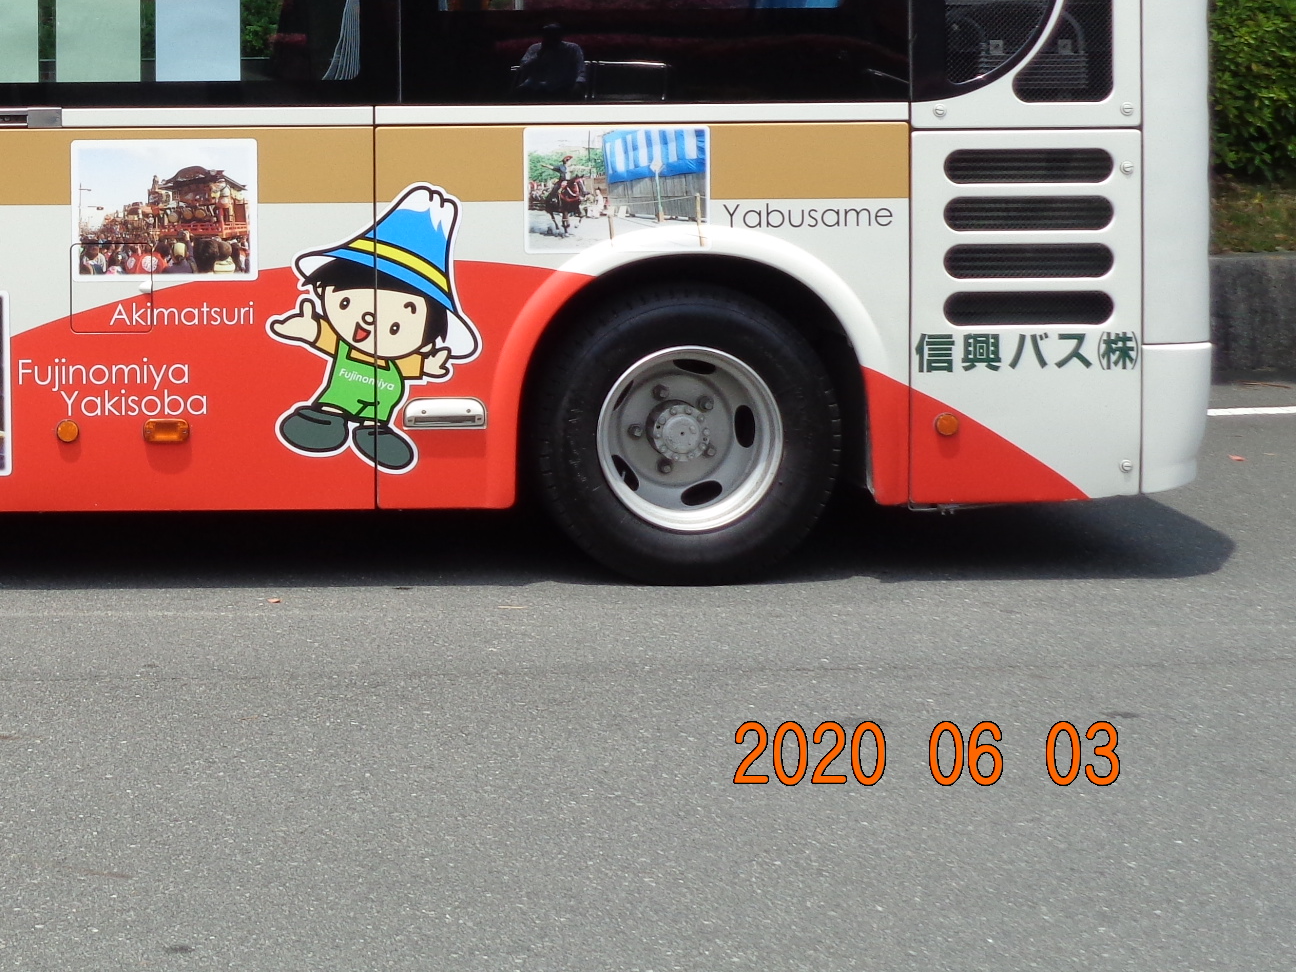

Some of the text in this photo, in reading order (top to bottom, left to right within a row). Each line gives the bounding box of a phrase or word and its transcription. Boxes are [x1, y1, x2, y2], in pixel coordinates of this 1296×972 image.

[722, 203, 894, 229] Yabusame
[109, 301, 255, 326] Akimatsuri
[17, 358, 190, 391] Fujinomiya
[60, 389, 208, 416] Yakisoba
